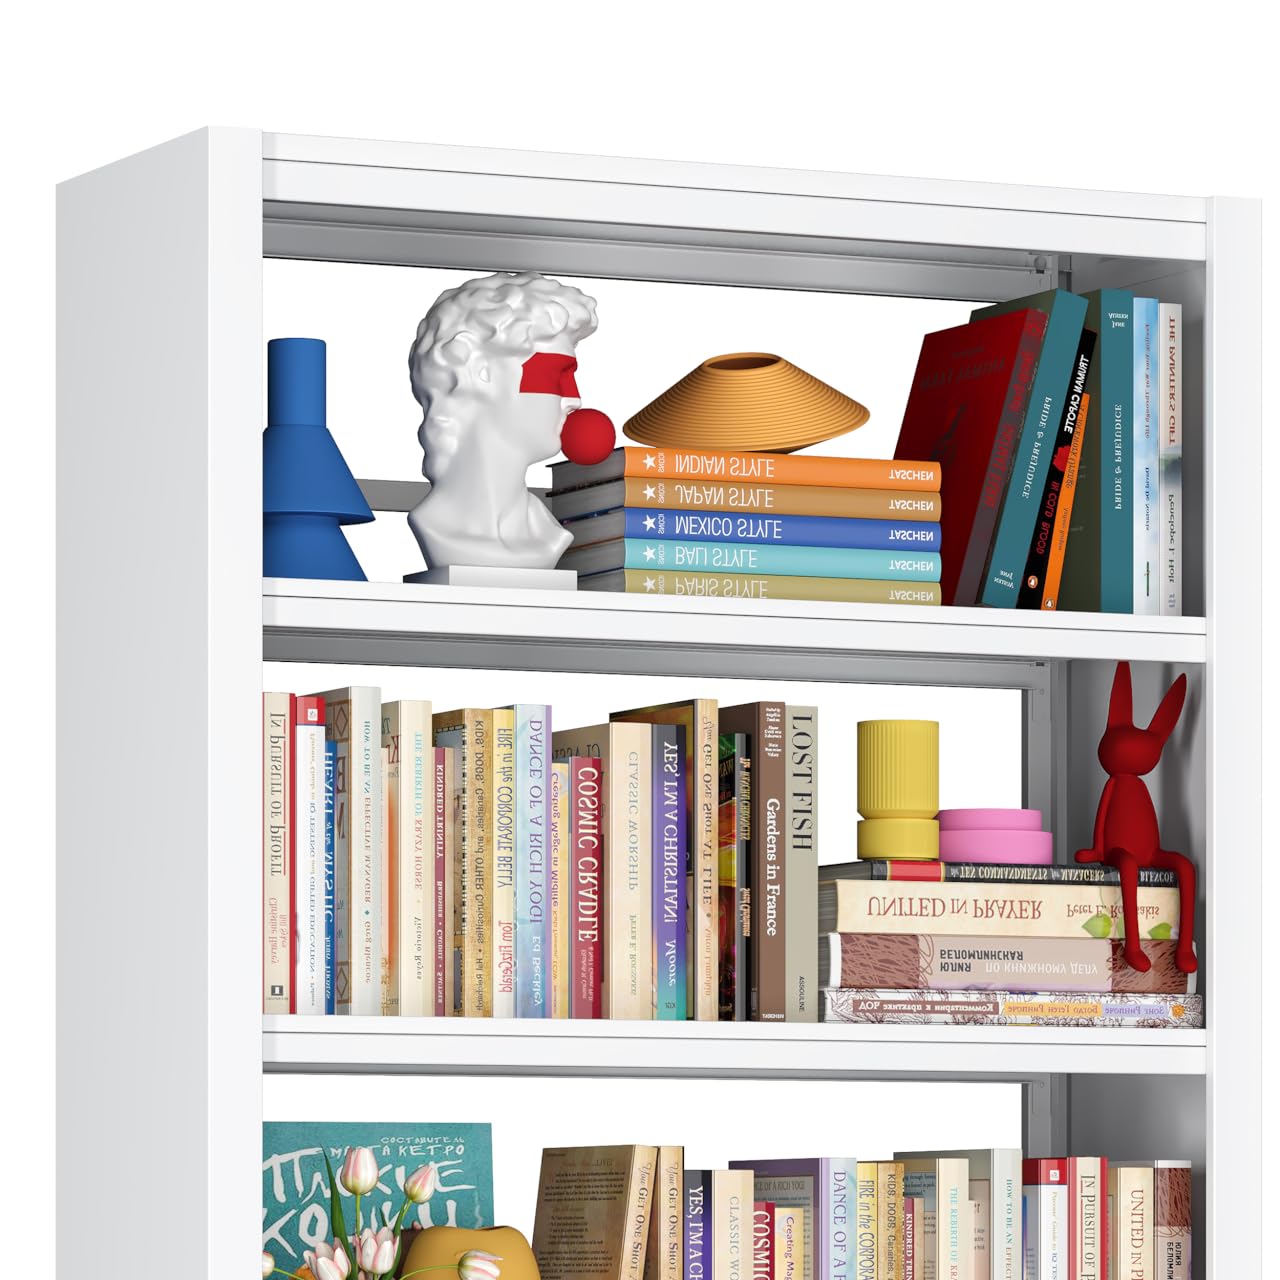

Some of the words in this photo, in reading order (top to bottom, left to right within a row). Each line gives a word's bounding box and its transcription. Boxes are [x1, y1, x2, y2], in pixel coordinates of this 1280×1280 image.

[792, 716, 812, 784] LOST
[767, 798, 780, 861] Gardens
[792, 792, 812, 851] FISH
[767, 867, 780, 881] in
[767, 885, 780, 936] France
[689, 1186, 703, 1218] YES,
[833, 1171, 846, 1231] DANCE
[689, 1222, 703, 1249] I'M
[730, 1196, 738, 1254] CLASSIC
[833, 1236, 846, 1255] OF
[689, 1252, 703, 1260] A
[833, 1259, 846, 1269] A
